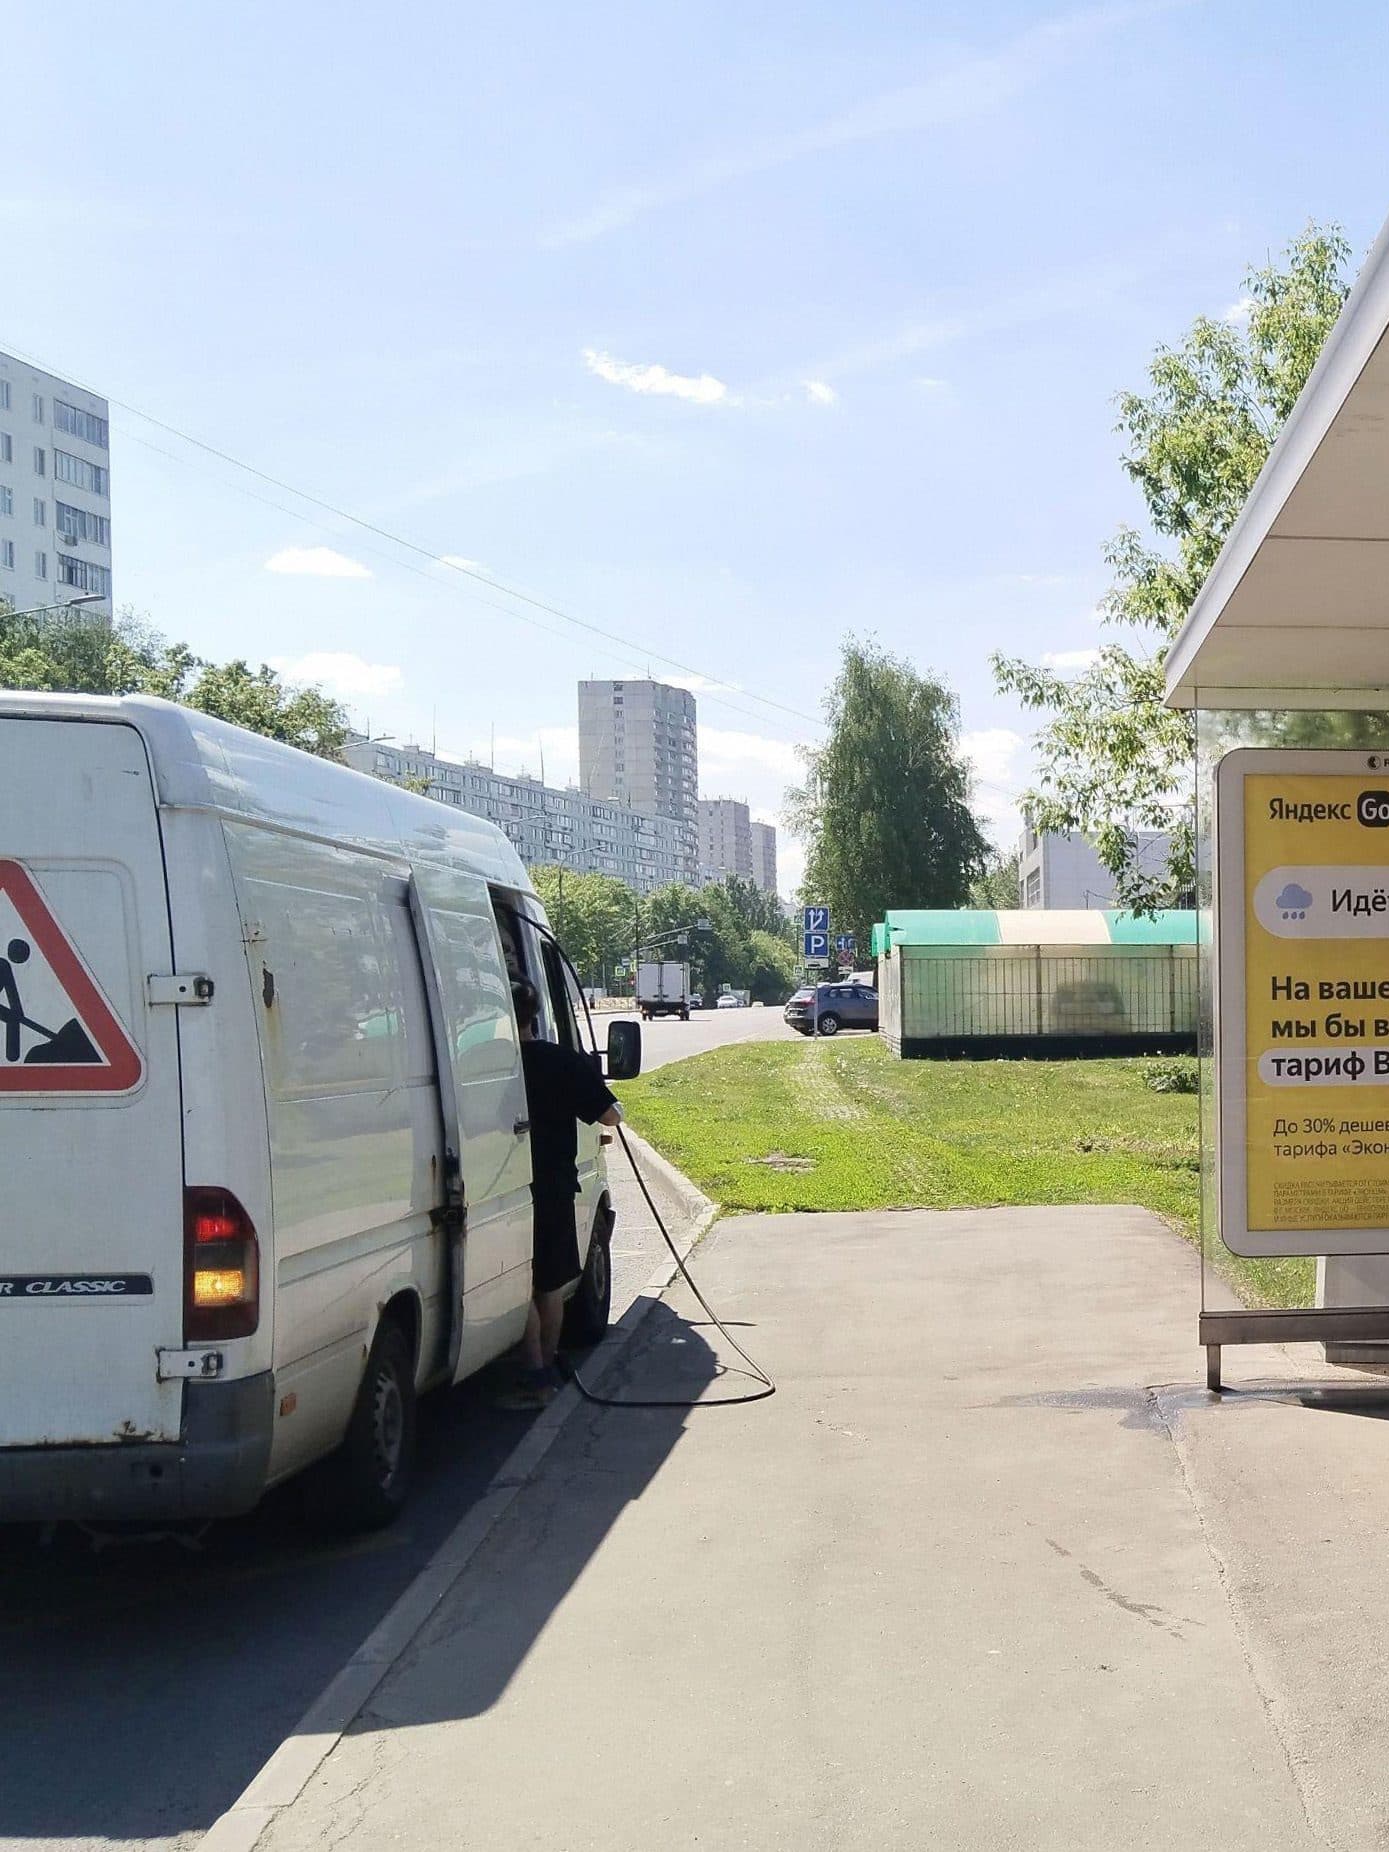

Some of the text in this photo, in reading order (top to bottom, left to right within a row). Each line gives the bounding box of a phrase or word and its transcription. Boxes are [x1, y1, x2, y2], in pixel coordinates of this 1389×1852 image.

[1269, 798, 1352, 823] Яндекс
[1271, 976, 1310, 1001] На
[1271, 1017, 1316, 1039] мы
[1324, 1013, 1365, 1038] бы
[1272, 1050, 1365, 1082] тариф
[1273, 1119, 1298, 1137] До
[1302, 1118, 1335, 1134] 30%
[1273, 1141, 1337, 1157] тарифа
[26, 1280, 126, 1293] CLASSIC
